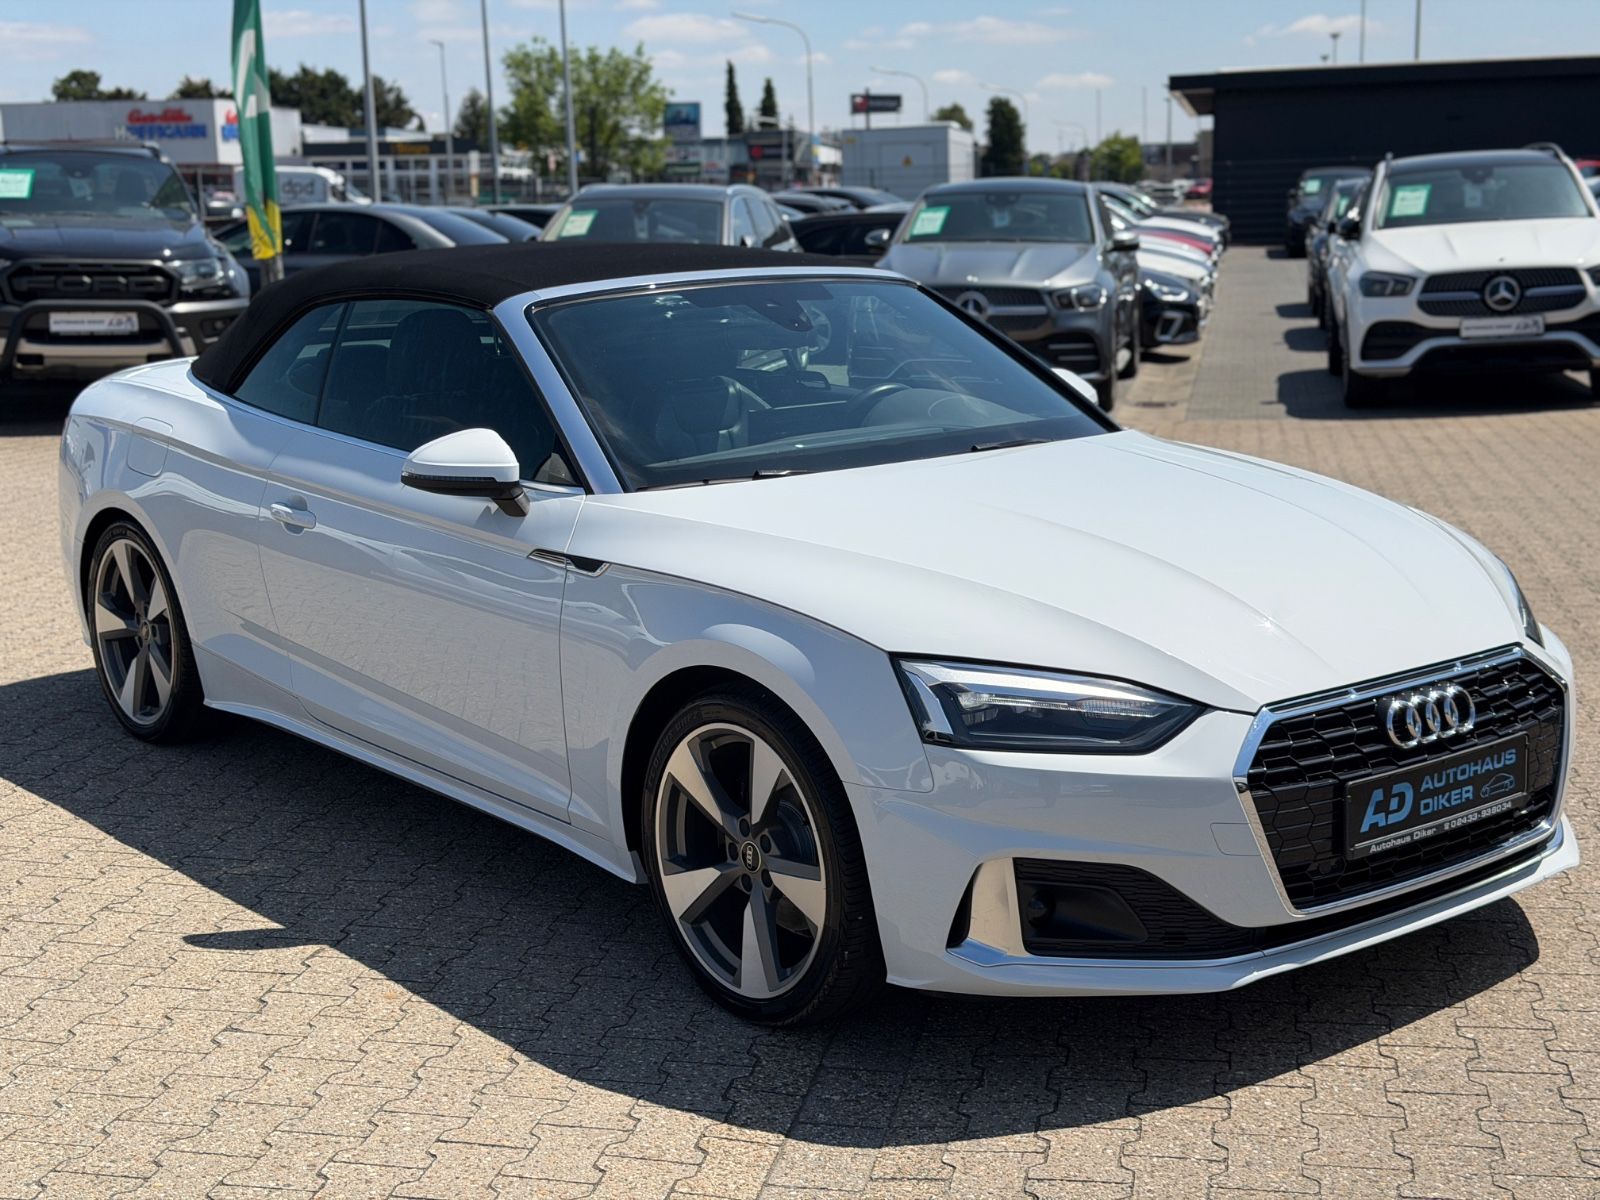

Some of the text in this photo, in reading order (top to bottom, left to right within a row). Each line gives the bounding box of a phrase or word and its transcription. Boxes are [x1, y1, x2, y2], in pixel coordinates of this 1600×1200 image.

[282, 178, 315, 200] dpd
[13, 274, 168, 292] FORD
[1420, 748, 1517, 792] AUTOHAUS
[1360, 782, 1414, 833] AD
[1420, 785, 1474, 815] DIKER
[1370, 835, 1411, 853] Autohaus
[1413, 827, 1437, 840] Diker
